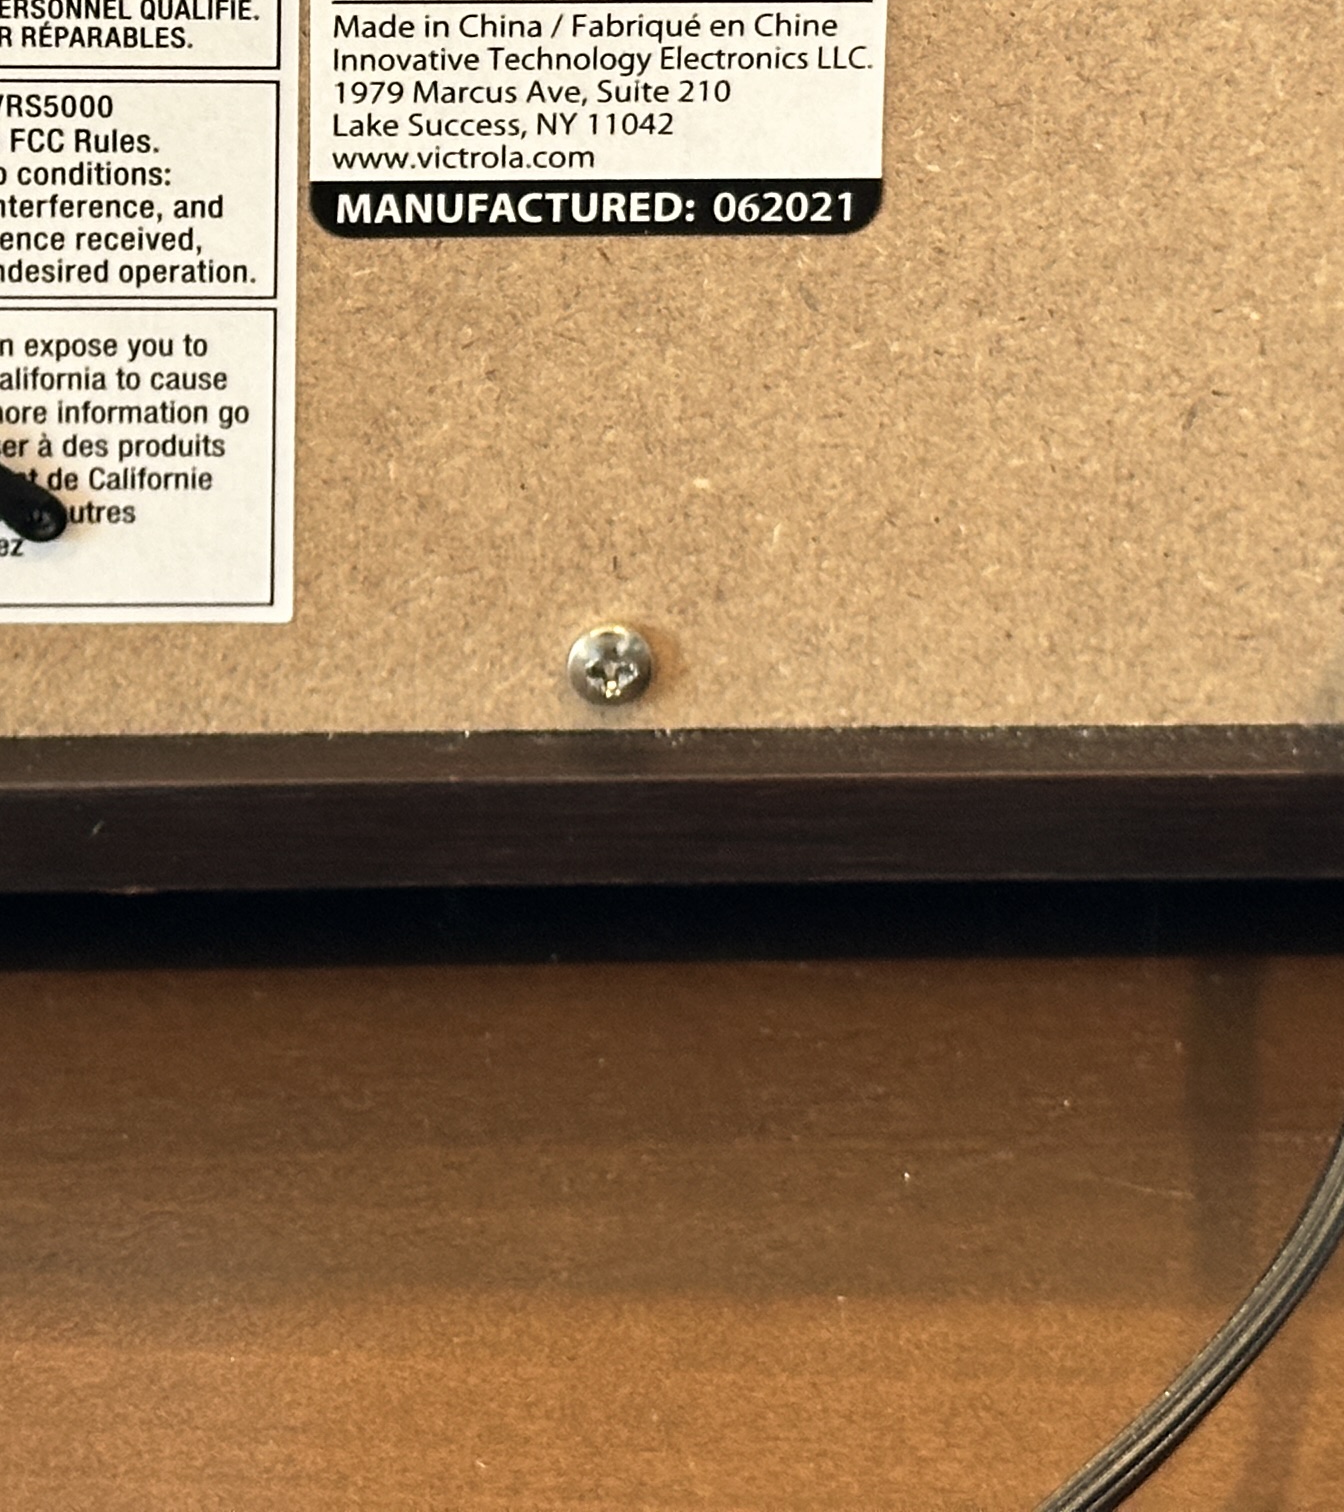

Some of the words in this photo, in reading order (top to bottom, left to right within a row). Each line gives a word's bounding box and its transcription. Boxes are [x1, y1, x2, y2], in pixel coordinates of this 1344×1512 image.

[333, 13, 415, 39] Made
[425, 15, 449, 38] in
[459, 13, 542, 38] China
[572, 13, 701, 44] Fabriqué
[710, 19, 744, 37] en
[754, 12, 838, 37] Chine
[334, 47, 480, 72] Innovative
[487, 45, 652, 77] Technology
[661, 45, 808, 70] Electronics
[818, 45, 872, 69] LLC.
[335, 81, 404, 104] 1979
[413, 80, 517, 104] Marcus
[526, 80, 587, 107] Ave,
[597, 79, 669, 103] Suite
[678, 80, 731, 103] 210
[333, 112, 399, 137] Lake
[408, 113, 527, 140] Success,
[537, 112, 578, 135] NY
[589, 112, 673, 136] 11042
[11, 128, 64, 153] FCC
[75, 128, 159, 153] Rules.
[332, 144, 595, 169] www.victrola.com
[337, 192, 695, 224] MANUFACTURED:
[713, 192, 852, 222] 062021
[24, 338, 118, 362] expose
[128, 338, 173, 362] you
[183, 334, 208, 357] to
